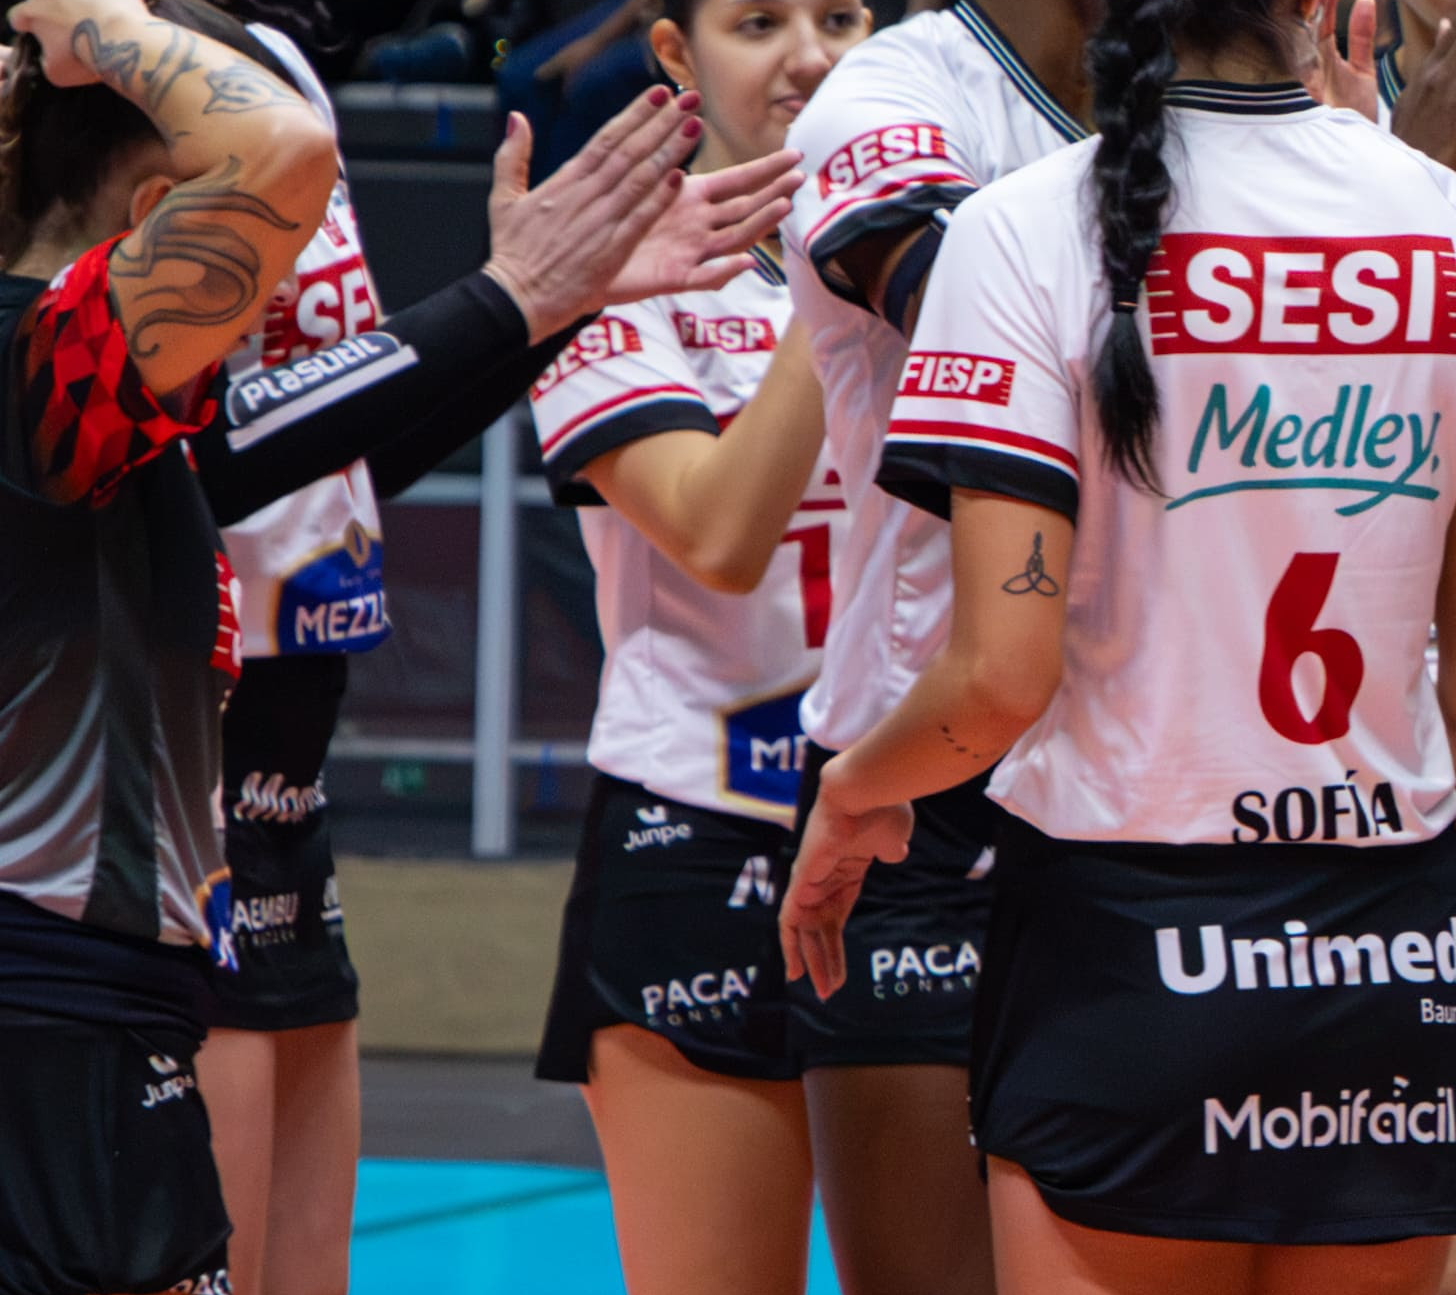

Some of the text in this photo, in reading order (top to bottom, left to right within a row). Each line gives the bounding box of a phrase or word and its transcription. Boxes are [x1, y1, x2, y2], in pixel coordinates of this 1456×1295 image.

[828, 127, 934, 192] SESI
[1182, 247, 1437, 346] SESI
[897, 356, 1004, 396] FIESP
[1257, 551, 1365, 746] 6
[1231, 769, 1404, 845] SOFÍA
